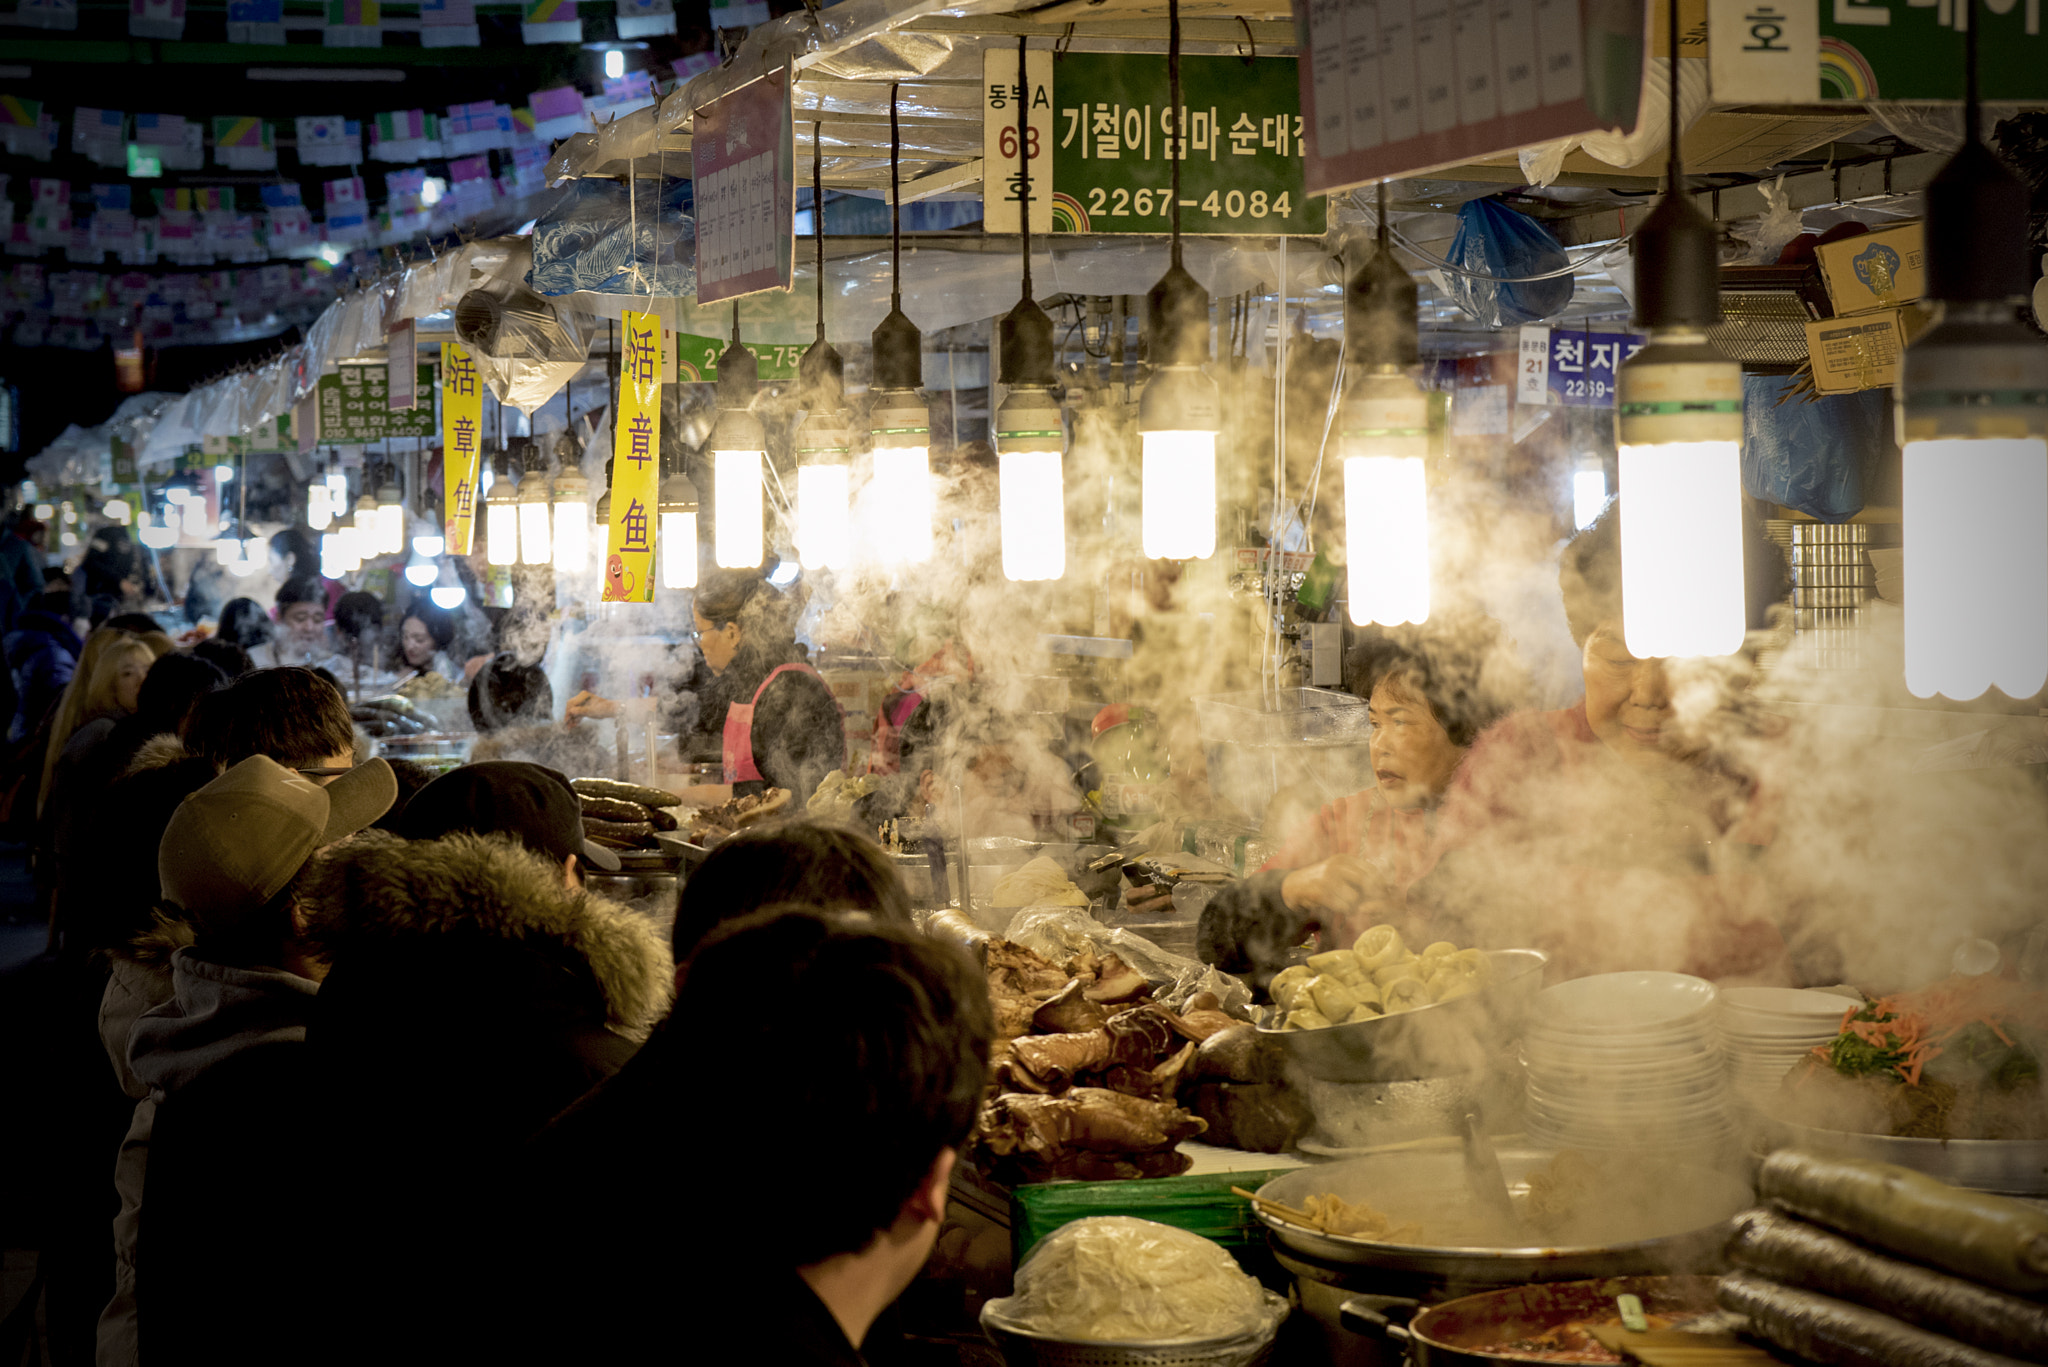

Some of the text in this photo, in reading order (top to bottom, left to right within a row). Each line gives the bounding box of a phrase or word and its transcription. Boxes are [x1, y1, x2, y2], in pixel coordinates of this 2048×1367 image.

[1742, 7, 1790, 52] 호
[999, 125, 1041, 160] 68
[1061, 102, 1150, 160] 기철이
[1160, 105, 1220, 162] 엄마
[1004, 171, 1037, 202] 호
[1088, 187, 1292, 219] 2267-4084
[1526, 359, 1543, 374] 21
